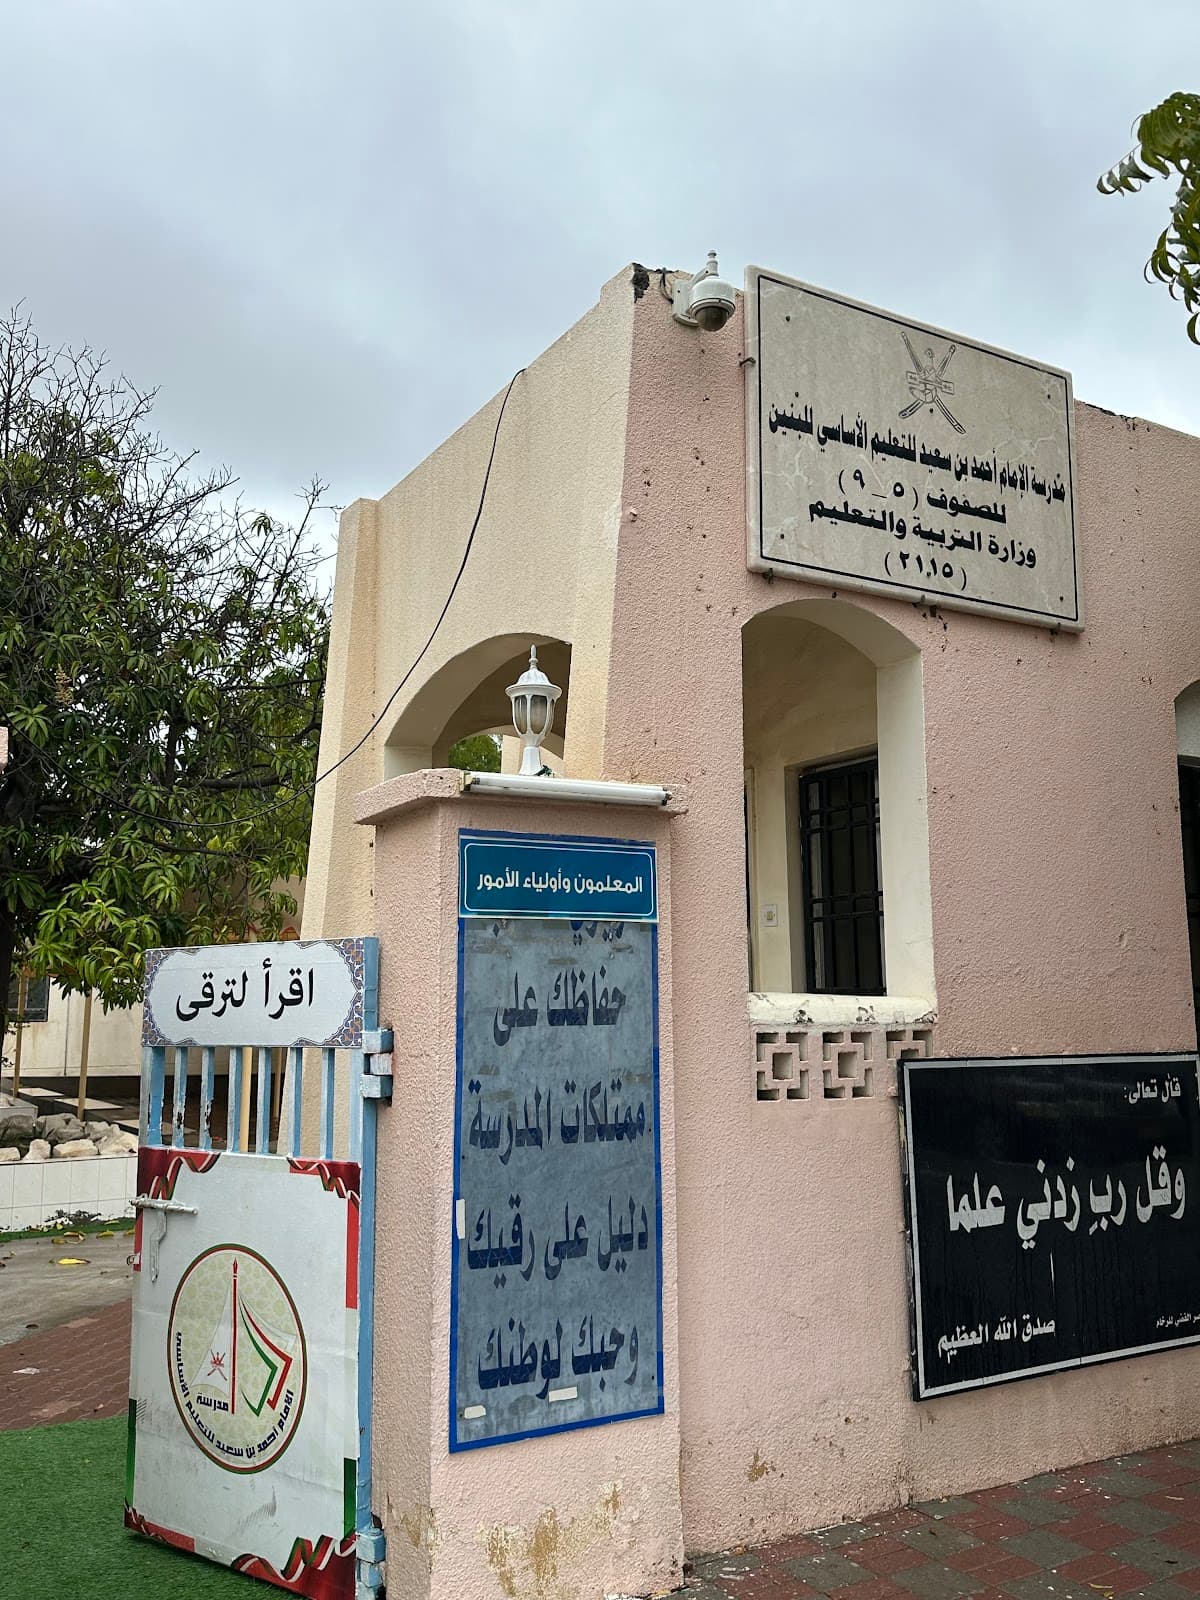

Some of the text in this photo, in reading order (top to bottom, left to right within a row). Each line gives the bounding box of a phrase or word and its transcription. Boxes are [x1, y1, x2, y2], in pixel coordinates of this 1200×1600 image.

[768, 402, 814, 441] للبنين
[816, 411, 868, 453] الأساسي
[870, 427, 917, 463] للتعليم
[919, 442, 952, 474] سعيد
[954, 453, 968, 482] بن
[971, 447, 997, 486] أحمد
[1031, 465, 1066, 505] مدرسة
[926, 487, 1007, 525] للصفوف
[808, 500, 1037, 569] وزارة التربية والتعليم
[477, 866, 643, 894] المعلمون وأولياء الأمور
[175, 957, 314, 1022] اقرأ لترقى
[493, 965, 627, 1047] حفاظك على
[468, 1078, 646, 1165] ممتلكات المدرسة
[946, 1172, 1006, 1234] علما
[1016, 1156, 1081, 1250] زدني
[1136, 1145, 1186, 1223] وقل
[467, 1193, 649, 1289] دليل على رقيك
[477, 1313, 639, 1400] وحبك لوطنك
[937, 1313, 1056, 1364] صدق الله العظيم
[184, 1400, 216, 1445] للتعليم
[196, 1392, 229, 1412] مدرسة
[215, 1440, 244, 1456] سعيد
[245, 1444, 256, 1459] بن
